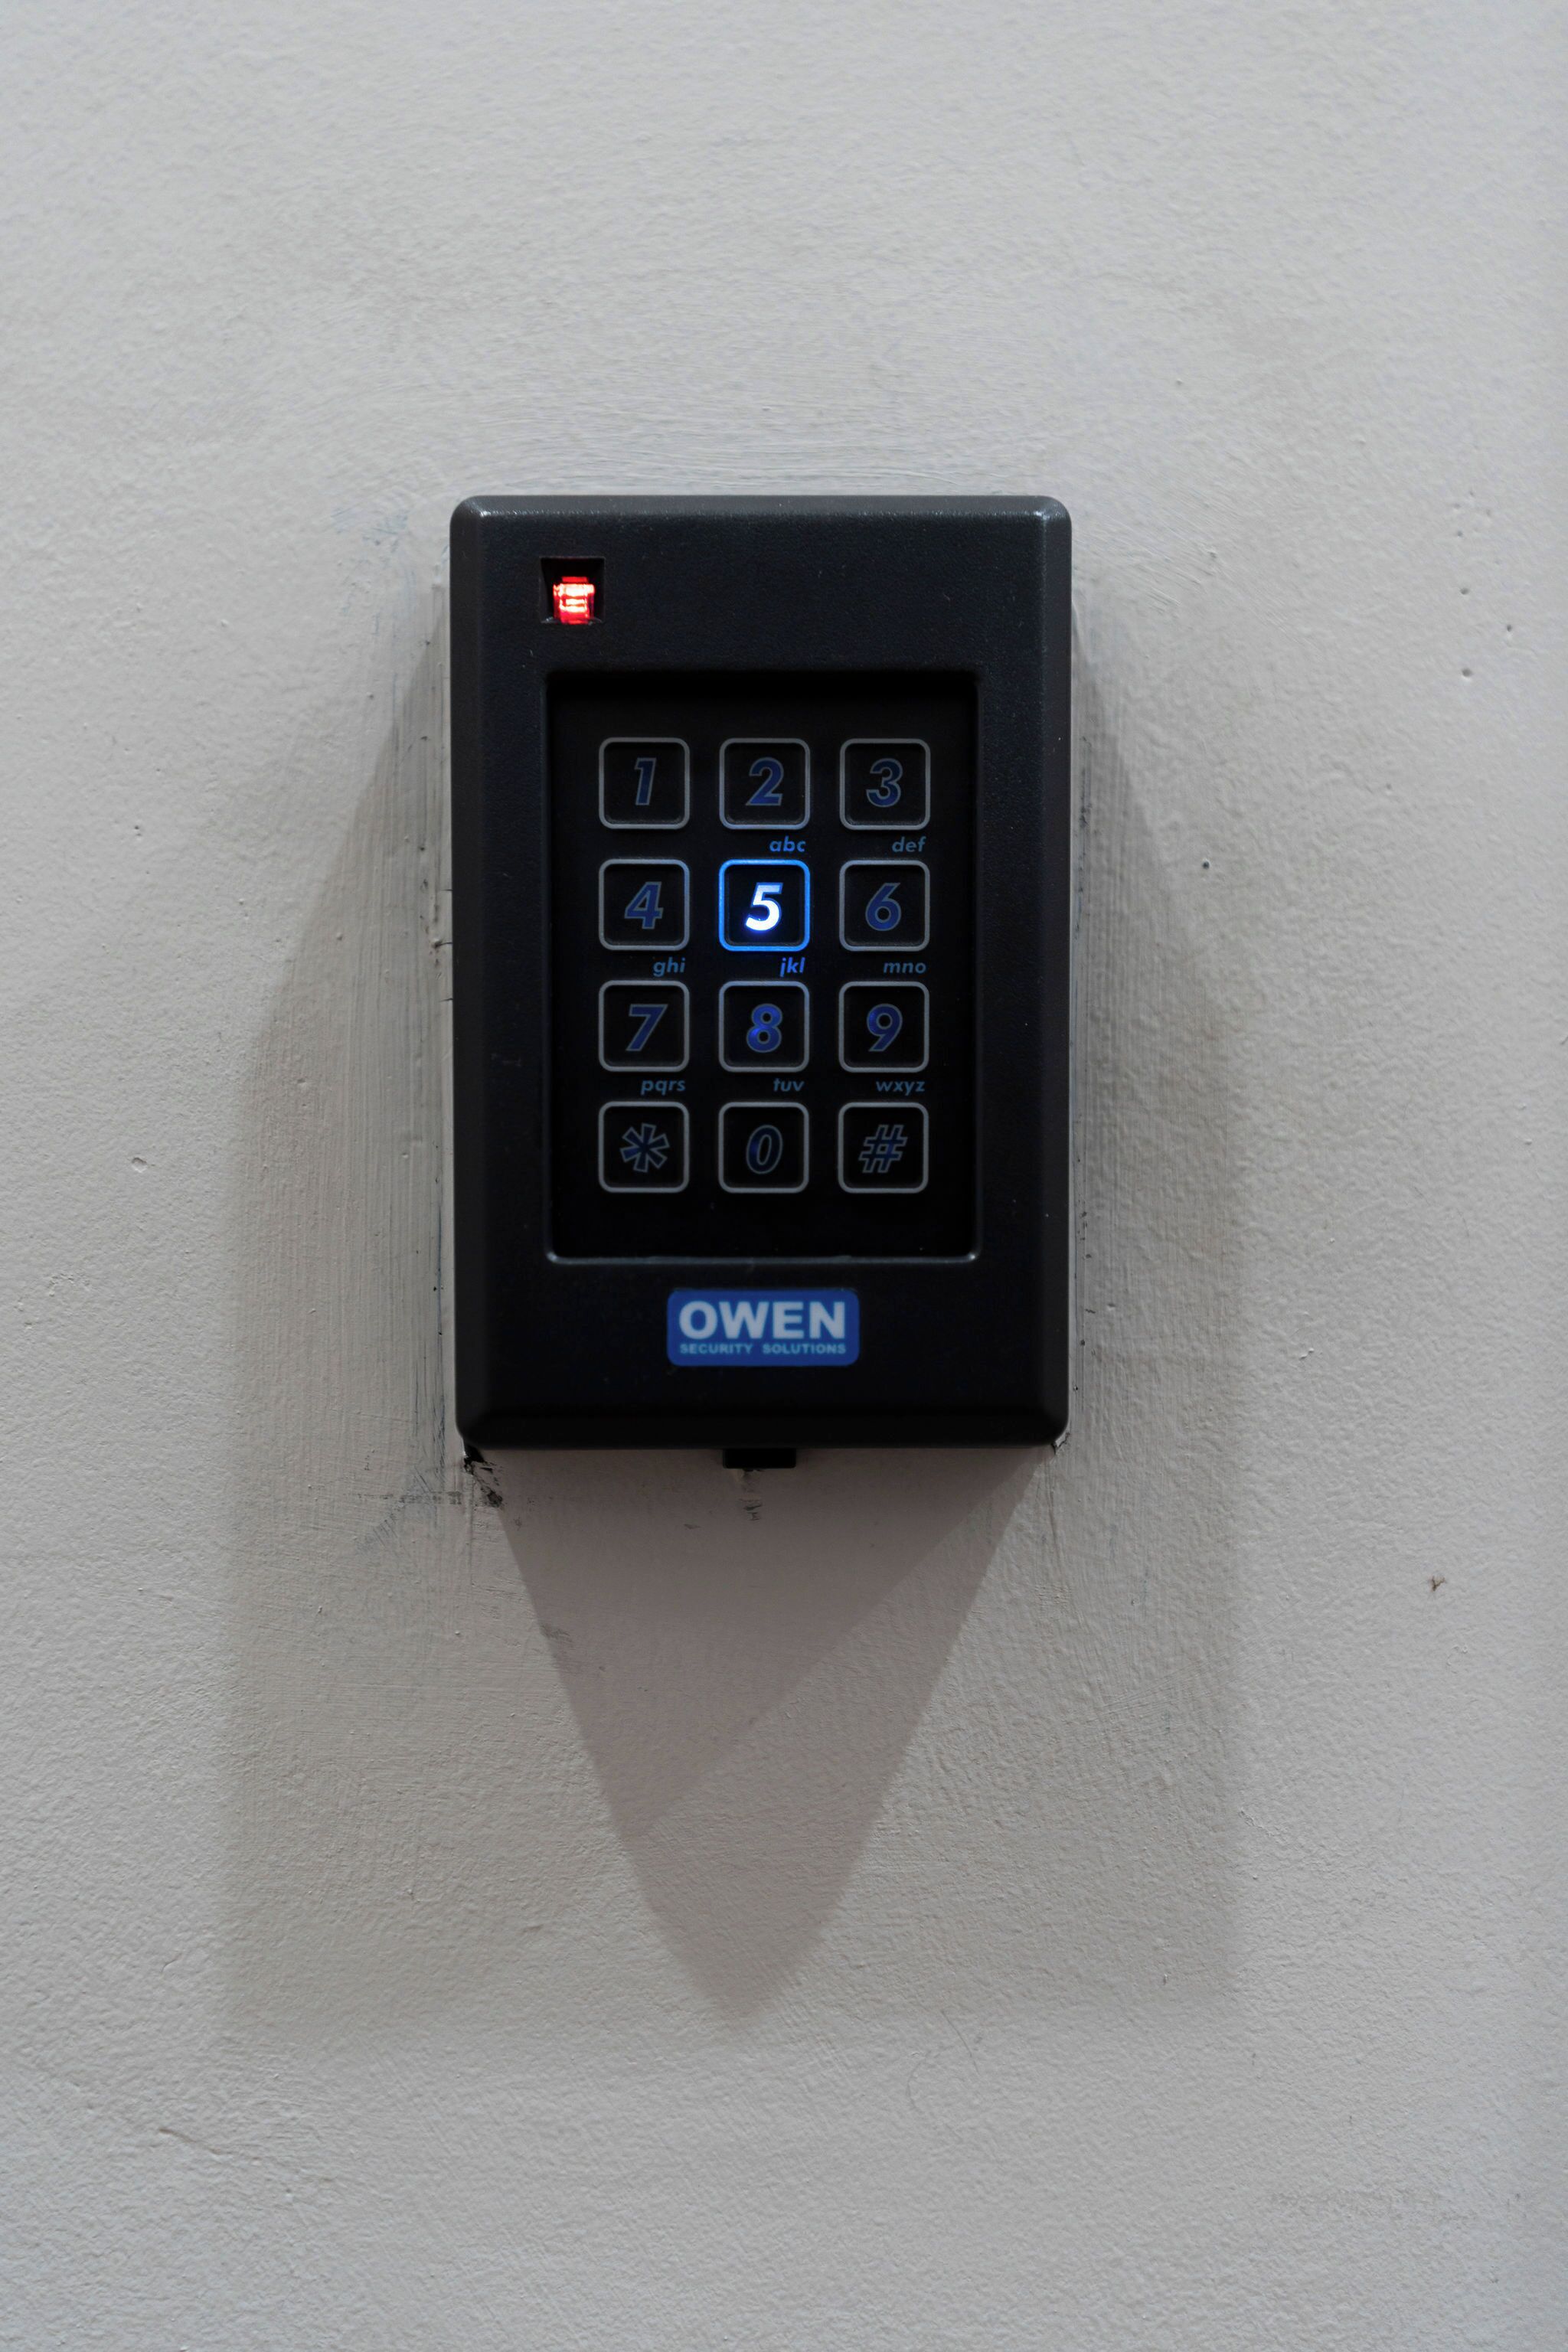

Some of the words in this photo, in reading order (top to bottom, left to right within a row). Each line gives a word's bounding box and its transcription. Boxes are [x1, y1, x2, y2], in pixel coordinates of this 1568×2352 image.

[635, 757, 656, 806] 1
[746, 757, 783, 806] 2
[866, 758, 903, 808] 3
[769, 835, 806, 853] abc
[892, 835, 926, 853] def
[625, 881, 664, 929] 4
[744, 882, 783, 933] 5
[865, 882, 902, 932] 6
[653, 956, 686, 977] ghi
[779, 956, 805, 977] jkl
[883, 962, 927, 975] mno
[626, 1004, 668, 1052] 7
[746, 1003, 782, 1053] 8
[867, 1003, 903, 1052] 9
[640, 1079, 686, 1096] pqrs
[773, 1077, 805, 1093] tuv
[875, 1080, 926, 1096] wxyz
[746, 1125, 783, 1174] 0
[858, 1124, 908, 1174] #
[679, 1301, 845, 1340] OWEN
[680, 1343, 753, 1354] SECURITY
[763, 1343, 846, 1354] SOLUTIONS
